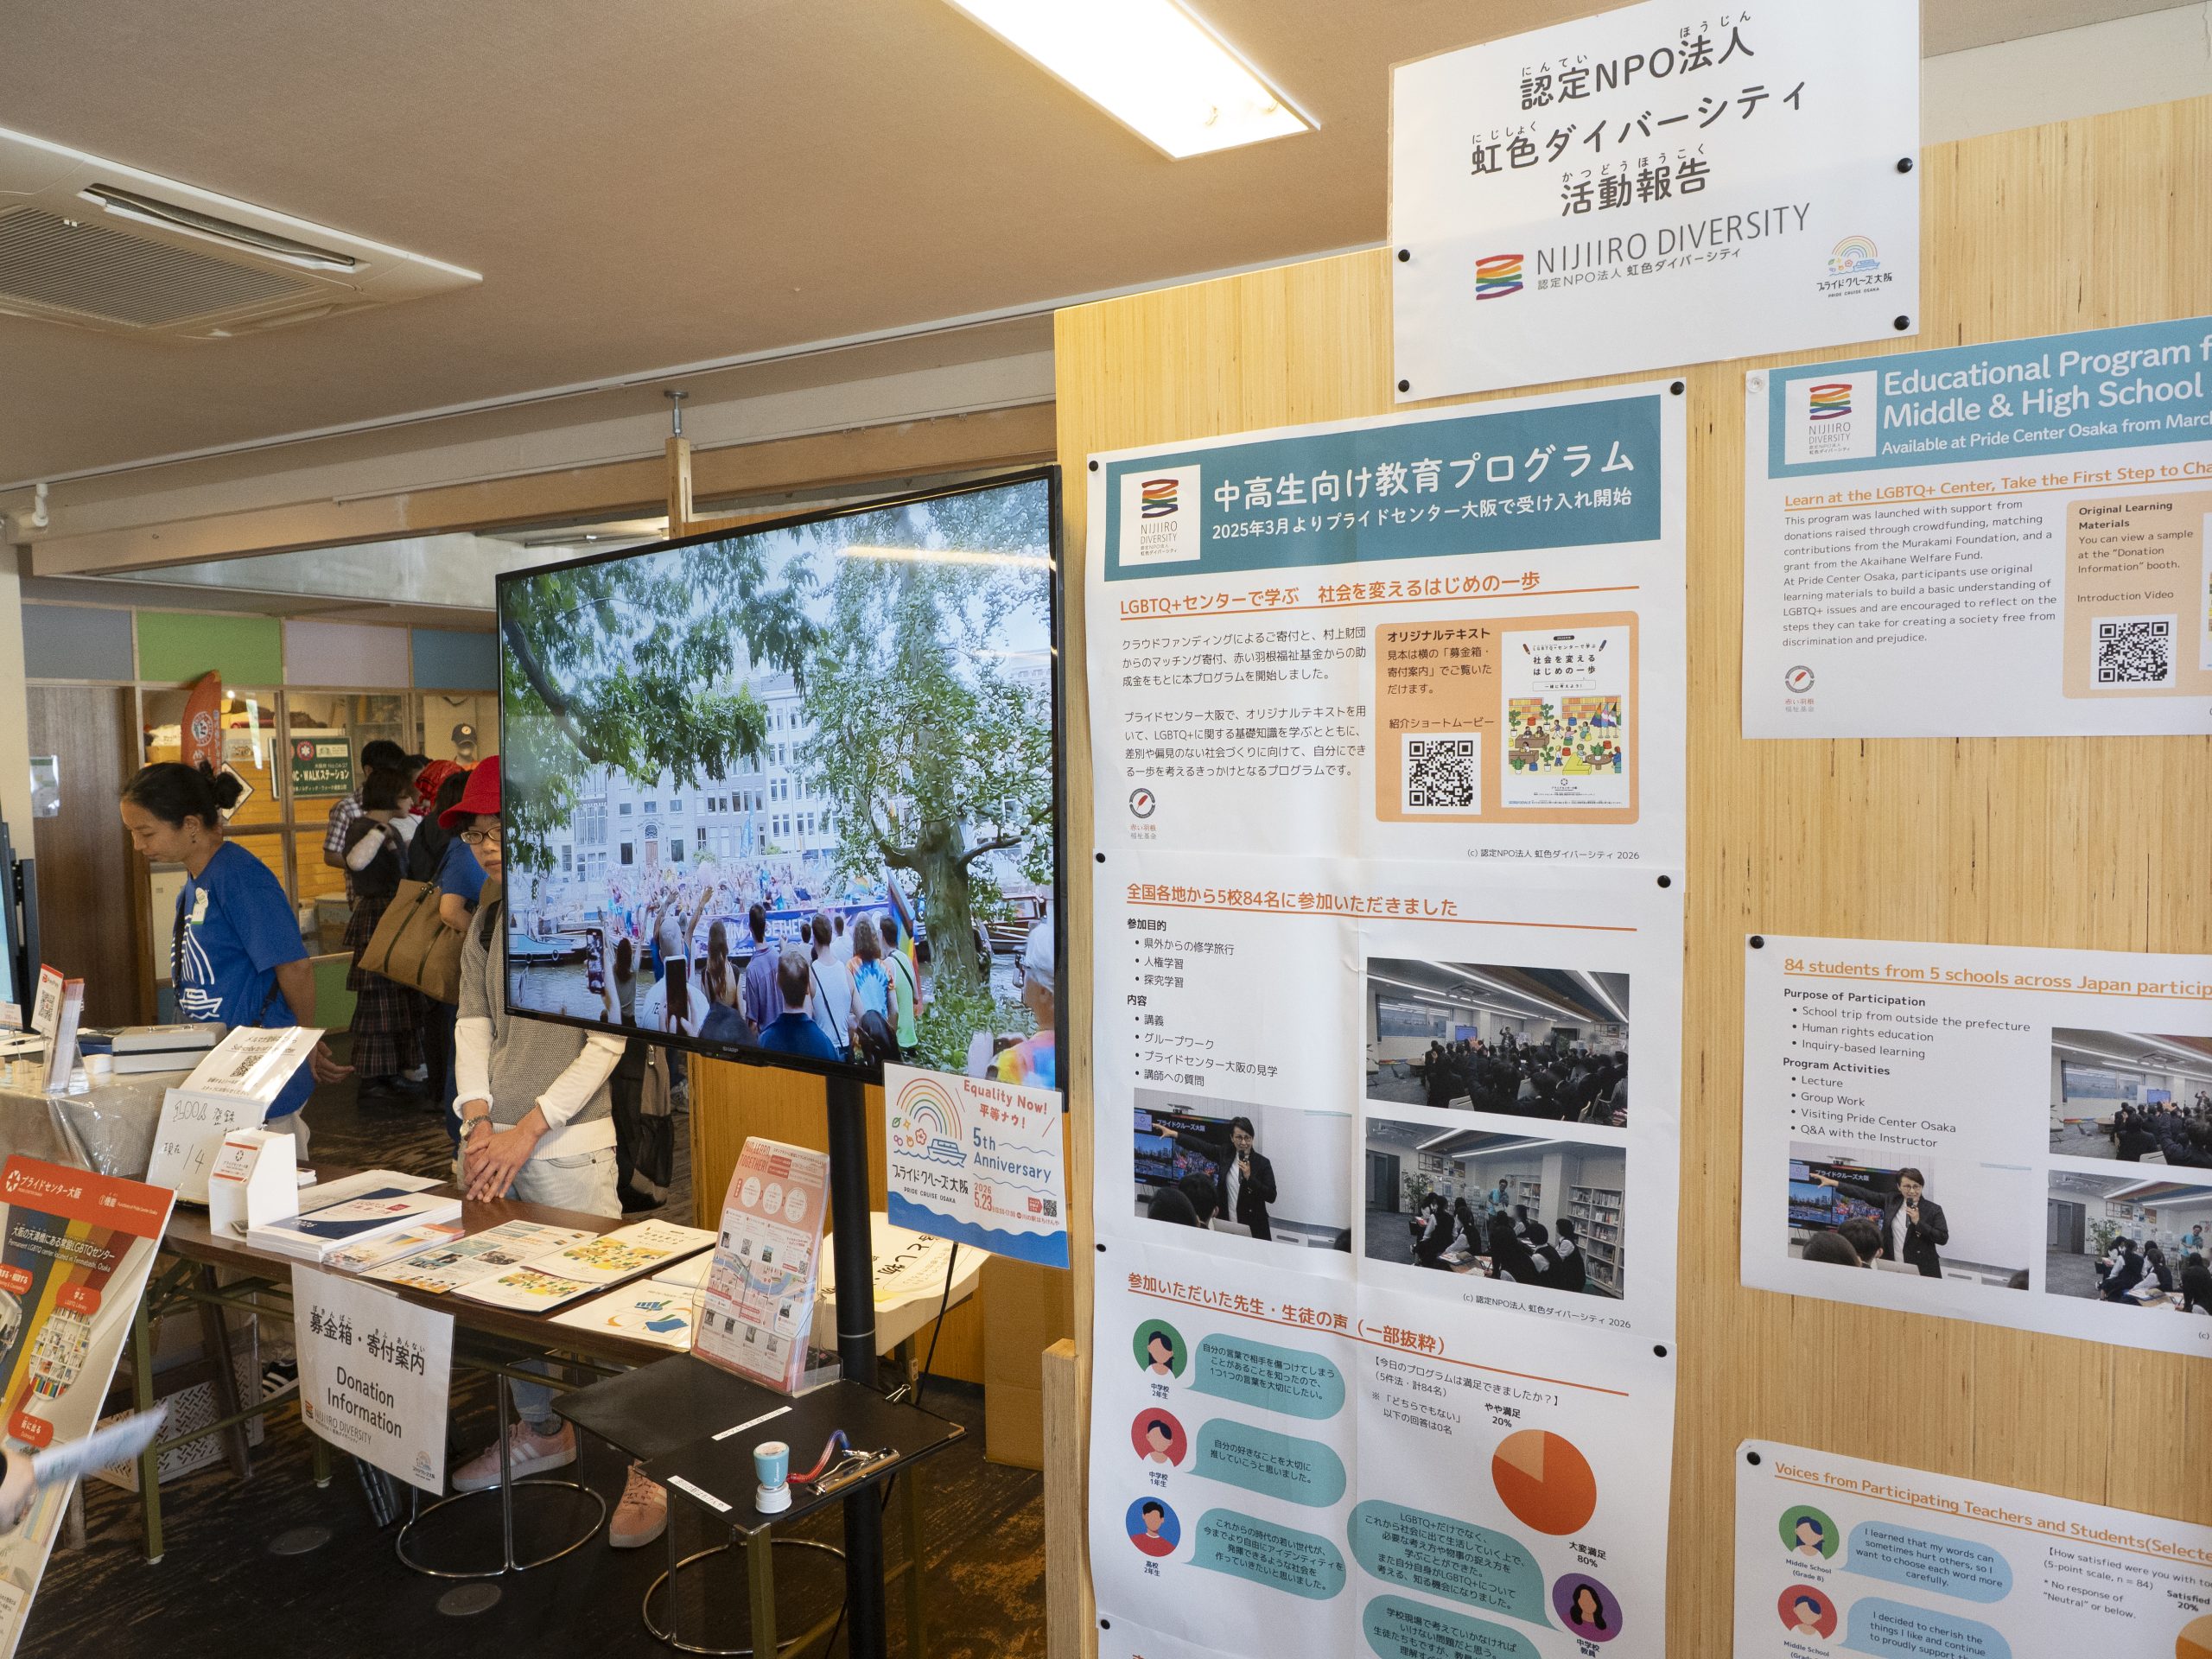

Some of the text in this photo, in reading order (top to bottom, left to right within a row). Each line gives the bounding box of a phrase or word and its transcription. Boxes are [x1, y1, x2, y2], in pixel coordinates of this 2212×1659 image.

[1520, 27, 1754, 111] 認定NPO法人
[1471, 82, 1805, 175] 虹色ダイバーシティ
[1560, 159, 1710, 217] 活動報告
[1537, 203, 1809, 275] NIJIIRO DIVERSITY
[1537, 249, 1740, 290] 認定NPO法人 虹色ダイバーシティ
[1885, 346, 2190, 396] Educational Program
[1883, 372, 2203, 429] Middle & High School
[1881, 437, 1948, 454] Available
[1950, 435, 1967, 448] at
[1970, 431, 2009, 447] Pride
[2012, 428, 2065, 442] Center
[2068, 422, 2118, 437] Osaka
[2120, 419, 2160, 433] from
[1214, 441, 1634, 512] 中高生向け教育プログラム
[1785, 496, 1823, 506] Learn
[1827, 493, 1842, 503] at
[1847, 490, 1872, 501] the
[1876, 485, 1936, 499] LGBTQ+
[1940, 481, 1995, 494] Center,
[2000, 477, 2037, 489] Take
[2041, 474, 2069, 486] the
[2073, 470, 2112, 483] First
[2117, 468, 2155, 480] Step
[2159, 466, 2178, 477] to
[1212, 487, 1631, 539] 2025年3月よりプライドセンター大阪で受け入れ開始
[1784, 517, 1805, 525] This
[1808, 515, 1849, 526] program
[1874, 508, 1920, 519] launched
[1923, 506, 1948, 515] with
[1950, 503, 1993, 514] support
[1996, 501, 2022, 510] from
[2078, 502, 2172, 516] Original Learning
[2078, 519, 2130, 530] Materials
[1318, 572, 1540, 603] 社会を変えるはじめの一歩
[2077, 593, 2141, 602] Introduction
[1387, 628, 1491, 643] オリジナルテキスト
[1387, 683, 1433, 695] だけます。
[1389, 716, 1494, 729] 紹介ショートムービー
[1126, 882, 1458, 916] 全国各地から5校84名に参加いただきました
[1127, 918, 1166, 931] 参加目的
[1143, 938, 1234, 956] 県外からの修学旅行
[1144, 957, 1184, 969] 人権学習
[1784, 959, 1804, 972] 84
[1808, 961, 1879, 976] students
[1885, 964, 1924, 979] from
[1929, 967, 1939, 980] 5
[1945, 969, 2008, 983] schools
[2014, 976, 2071, 987] across
[2076, 976, 2131, 990] Japan
[1143, 975, 1184, 988] 探究学習
[1127, 995, 1147, 1007] 内容
[1783, 988, 1828, 1001] Purpose
[1847, 993, 1925, 1007] Participation
[1144, 1014, 1164, 1027] 講義
[1802, 1007, 2031, 1032] School trip from outside the prefecture
[1144, 1033, 1214, 1050] グループワーク
[1144, 1051, 1278, 1077] プライドセンター大阪の見学
[1783, 1058, 1890, 1075] Program Activities
[1143, 1069, 1205, 1087] 講師への質問
[1801, 1076, 1843, 1088] Lecture
[963, 1080, 1047, 1115] Equality Now!
[973, 1127, 995, 1151] 5th
[973, 1152, 1051, 1183] Anniversary
[20, 1175, 83, 1199] プライドセンター大阪
[919, 1191, 938, 1199] CRUISE
[974, 1182, 992, 1194] 2026
[974, 1192, 993, 1211] 5.23
[310, 1313, 425, 1375] 募金箱・寄付案内
[336, 1367, 394, 1408] Donation
[1151, 1382, 1169, 1394] 中学校
[327, 1388, 401, 1439] Information
[1383, 1408, 1452, 1435] 以下の回答は0名
[1484, 1403, 1522, 1419] やや満足
[1491, 1416, 1512, 1427] 20%
[340, 1421, 372, 1445] DIVERSITY
[1775, 1462, 1819, 1481] Voices
[1823, 1472, 1858, 1489] from
[1861, 1480, 1959, 1510] Participating
[1963, 1501, 2032, 1525] Teachers
[2037, 1520, 2065, 1531] and
[1568, 1542, 1605, 1560] 大変満足
[1871, 1529, 1904, 1543] learned
[1907, 1538, 1927, 1548] that
[1929, 1544, 1943, 1554] my
[1946, 1548, 1974, 1559] words
[1976, 1554, 1993, 1563] can
[1577, 1555, 1598, 1567] 80%
[2166, 1591, 2210, 1605] Satisfied
[2177, 1602, 2198, 1611] 20%
